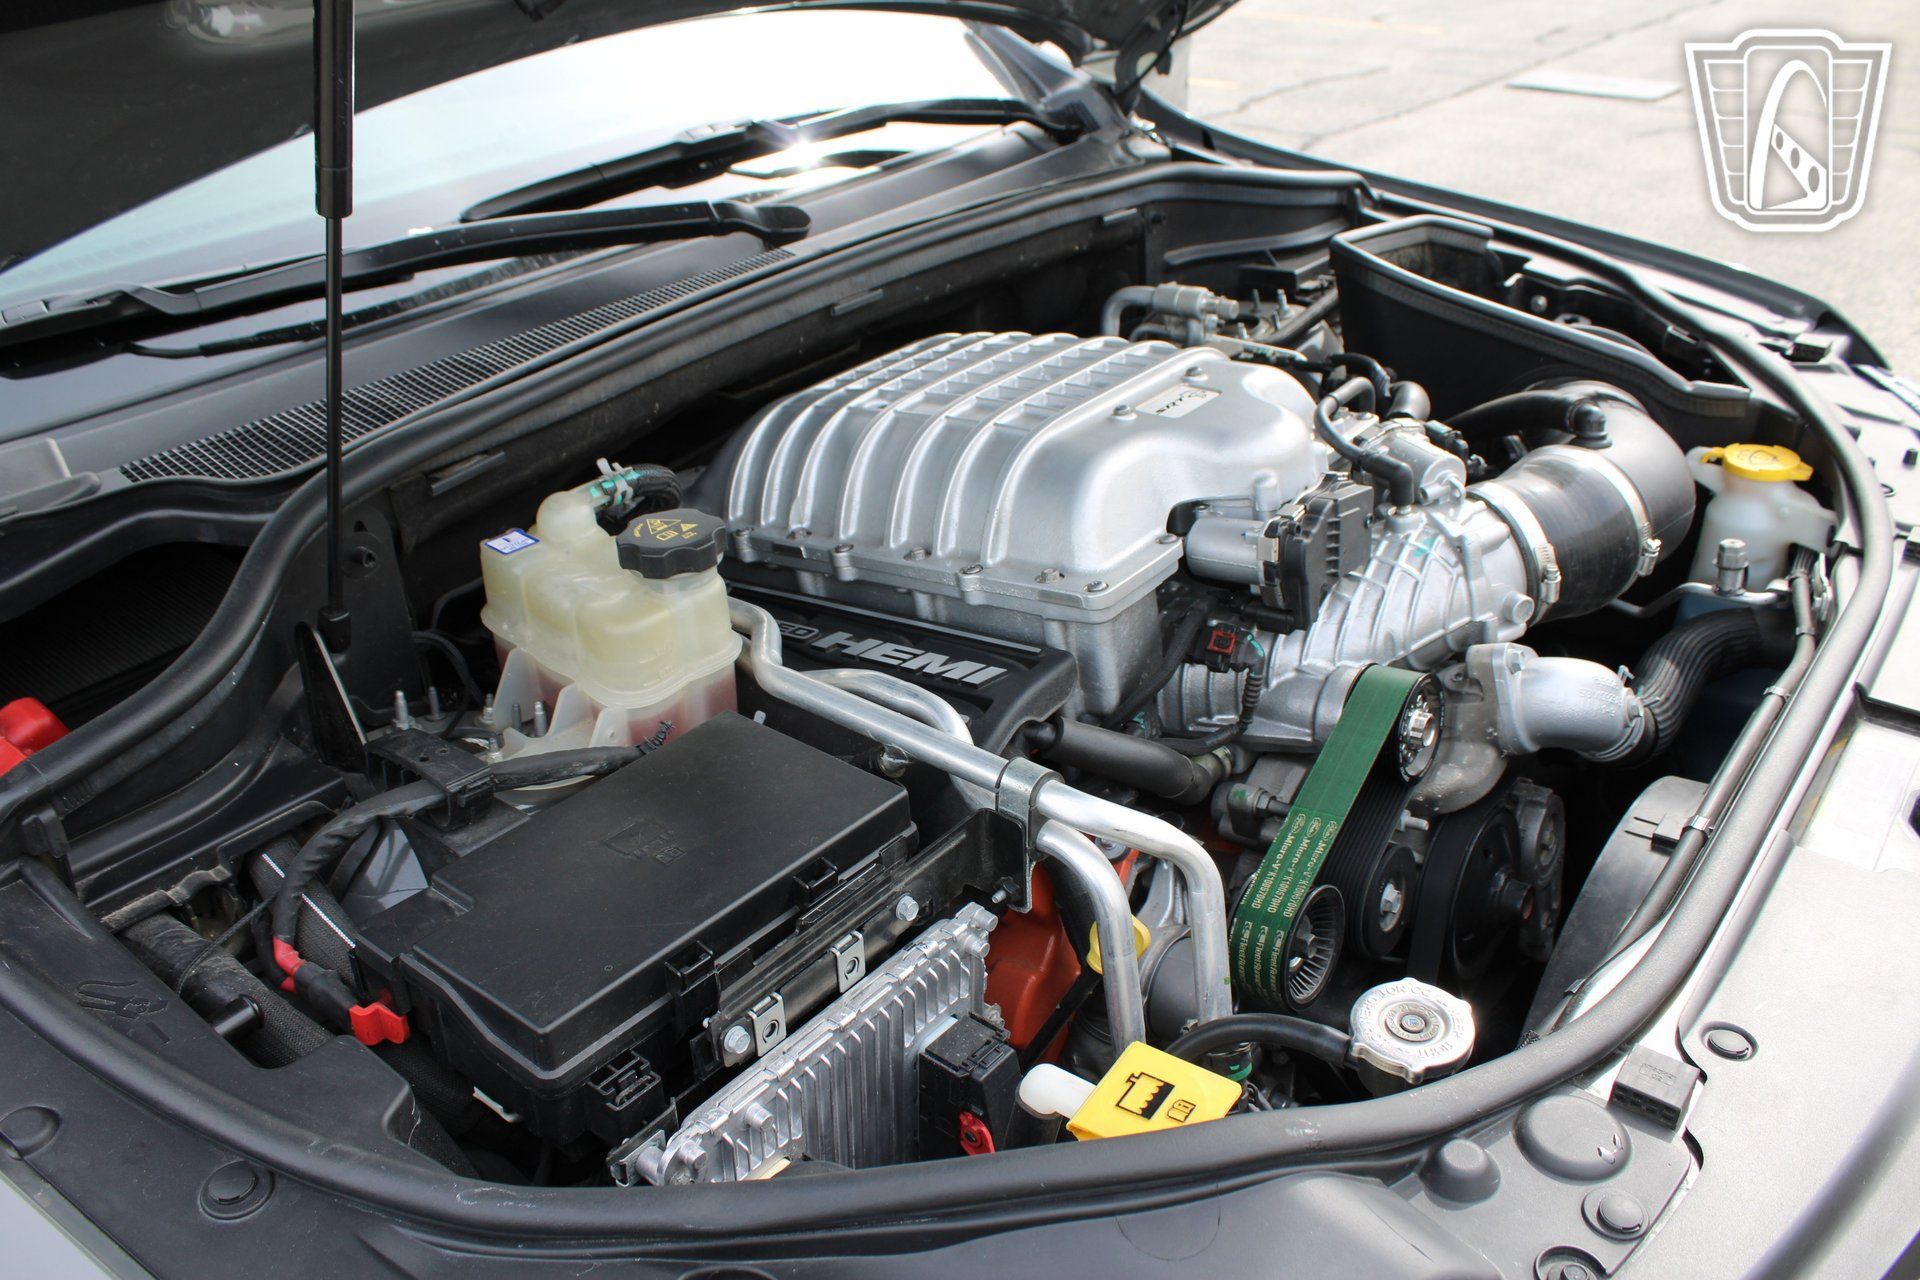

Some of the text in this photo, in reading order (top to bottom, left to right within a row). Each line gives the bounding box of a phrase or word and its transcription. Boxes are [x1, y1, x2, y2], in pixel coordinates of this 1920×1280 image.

[811, 631, 1008, 687] HEMI
[1270, 834, 1296, 869] Micro-V
[1287, 836, 1311, 874] Micro-V
